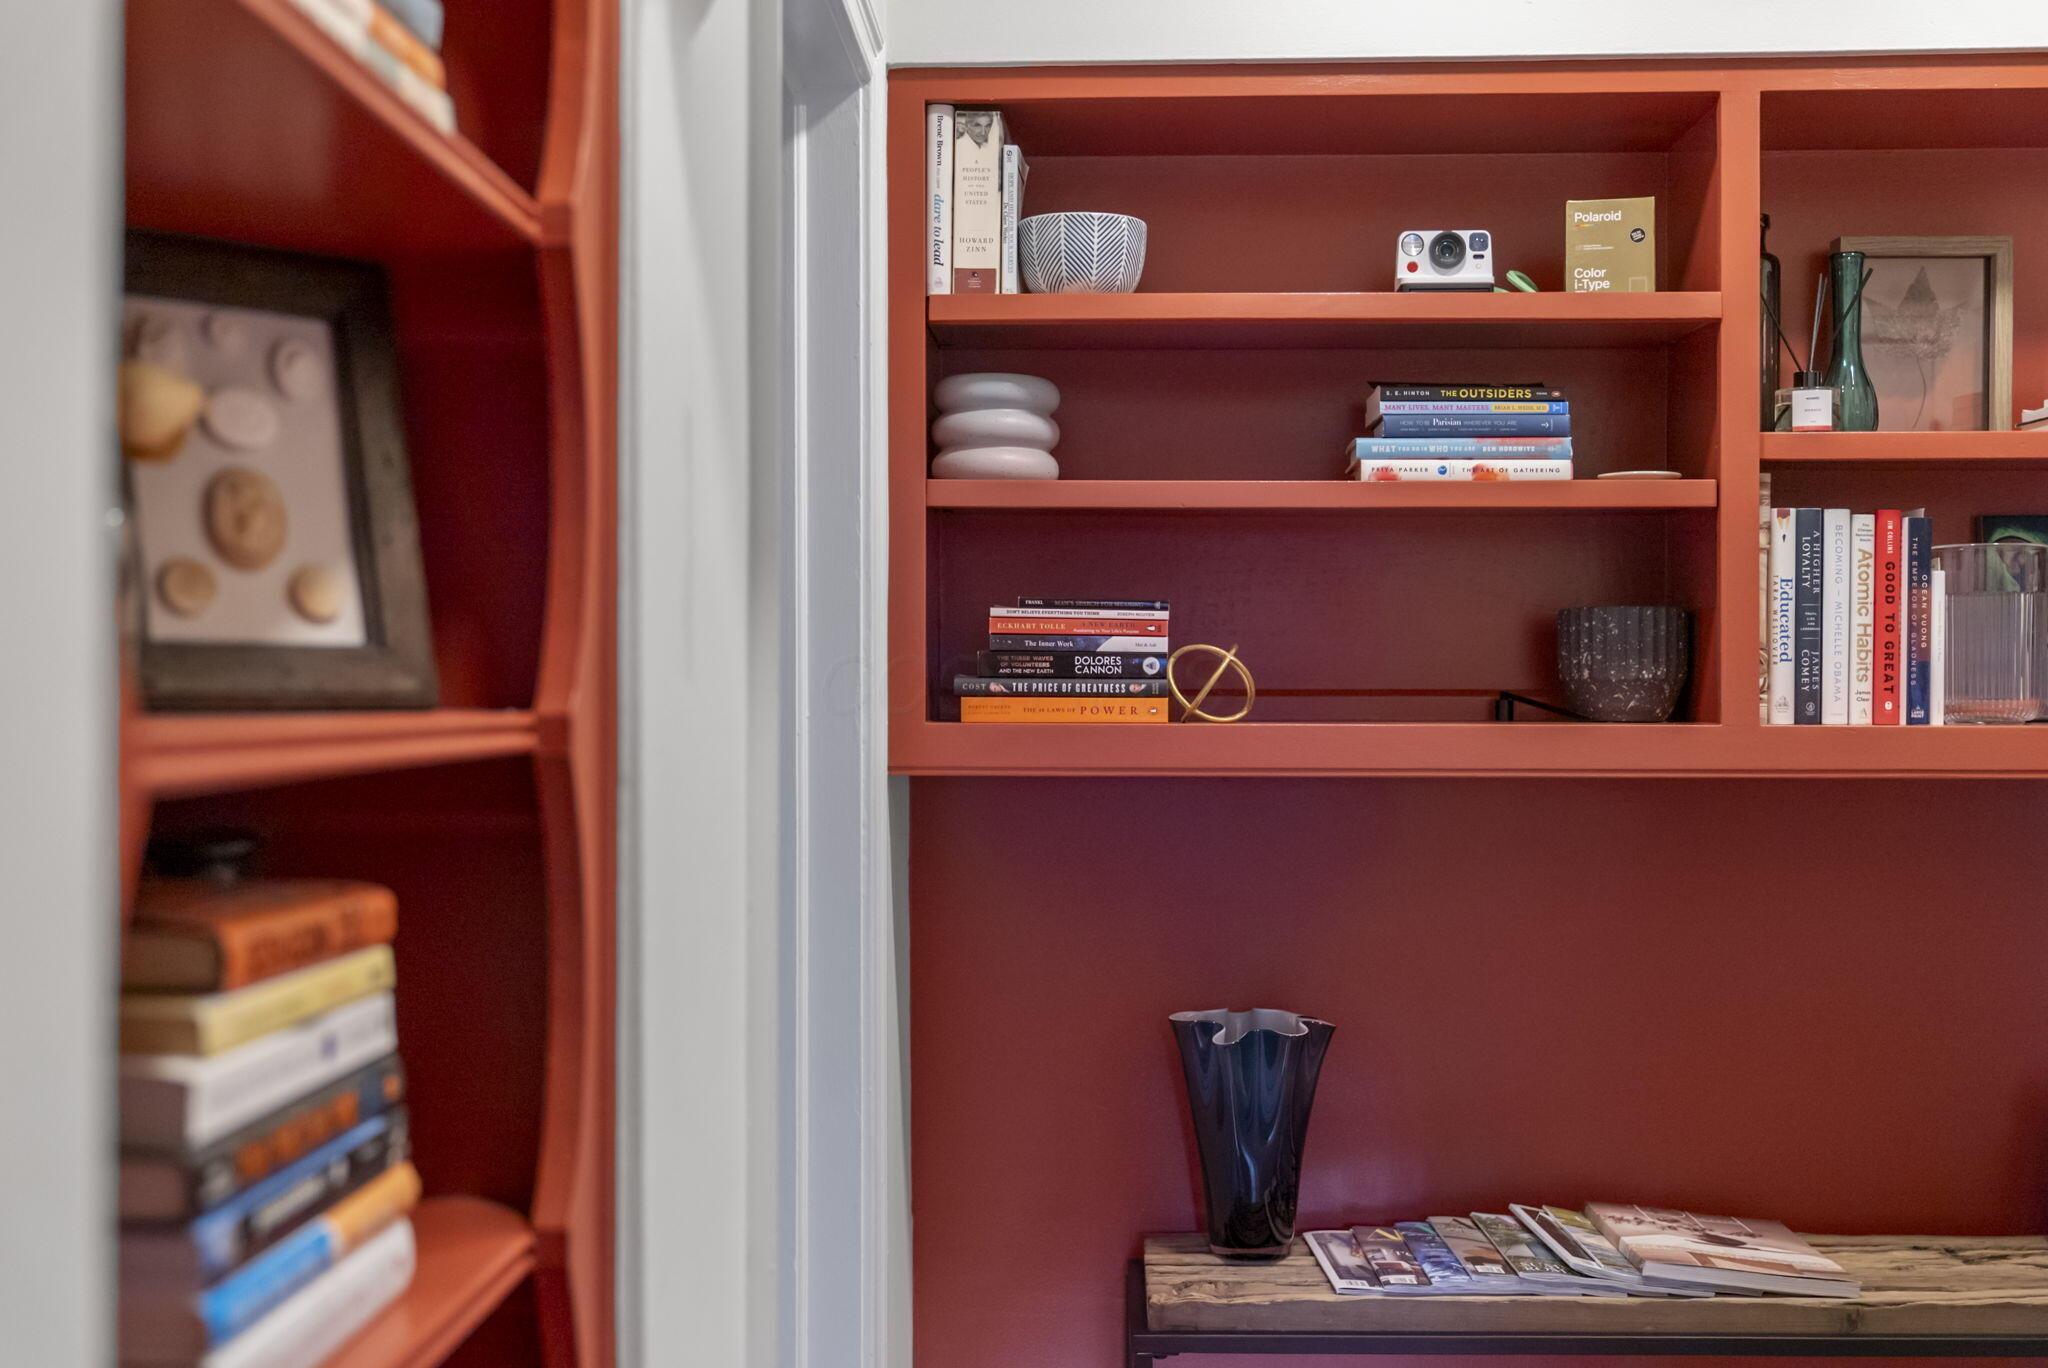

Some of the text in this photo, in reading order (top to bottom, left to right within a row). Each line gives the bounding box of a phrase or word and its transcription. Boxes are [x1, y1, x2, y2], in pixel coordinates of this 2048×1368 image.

[934, 194, 944, 224] dare
[1574, 210, 1622, 223] Polaroid
[934, 226, 942, 237] to
[934, 239, 944, 266] lead
[1574, 268, 1606, 278] Color
[1574, 279, 1610, 291] i-Type
[1460, 389, 1532, 398] OUTSIDERS
[1432, 418, 1461, 426] Parisian
[1802, 537, 1810, 588] LOYALTY
[1835, 525, 1843, 584] BECOMING
[1857, 548, 1872, 616] Atomic
[1779, 578, 1792, 663] Educated
[1885, 561, 1895, 694] GOOD TO GREAT
[1912, 614, 1918, 626] OF
[1075, 656, 1121, 665] DOLORES
[1856, 623, 1872, 683] Habits
[1075, 666, 1121, 674] CANNON
[1801, 649, 1809, 692] COMEY
[1811, 651, 1819, 690] JAMES
[1012, 682, 1126, 693] THE PRICE OF GREATNESS
[1833, 662, 1841, 702] OBAMA
[1080, 706, 1139, 715] POWER
